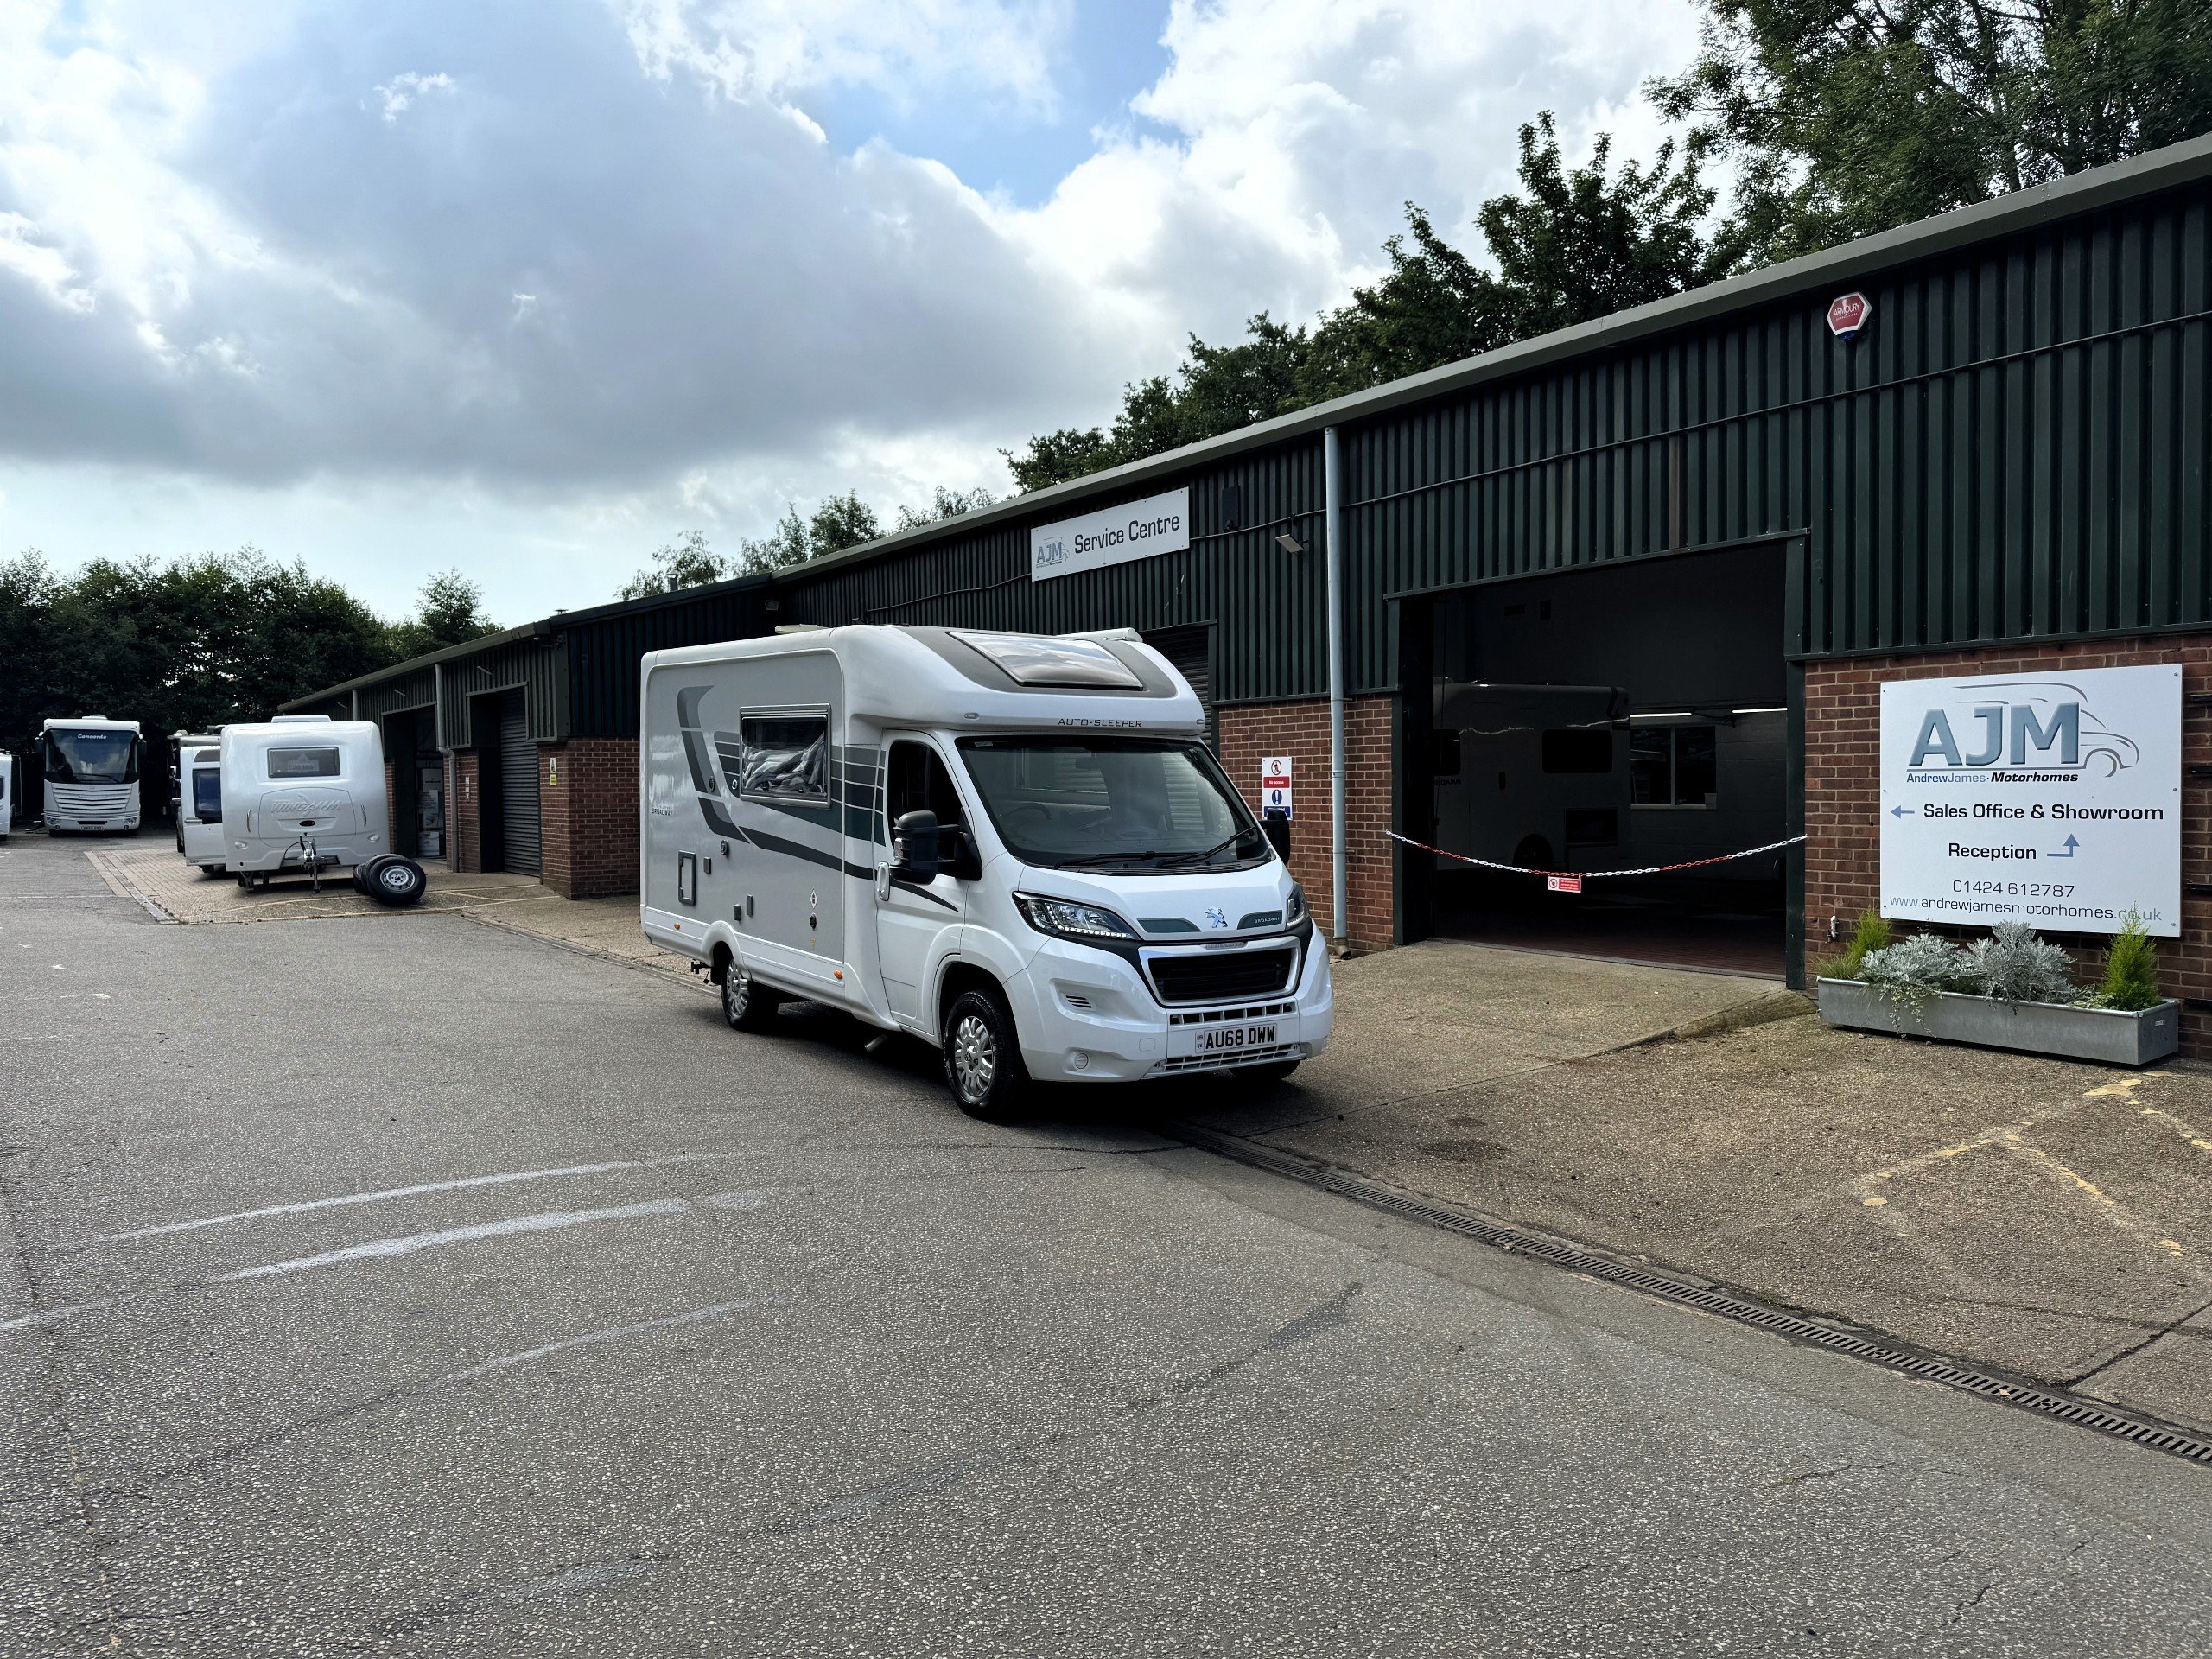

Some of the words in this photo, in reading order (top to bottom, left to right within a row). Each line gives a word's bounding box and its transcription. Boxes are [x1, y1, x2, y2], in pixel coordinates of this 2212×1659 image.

[1036, 541, 1062, 563] AJM
[1074, 527, 1124, 554] Service
[1128, 515, 1179, 541] Centre
[1908, 702, 2080, 766] AJM
[1991, 772, 2079, 783] Motorhomes
[1923, 804, 1967, 819] Sales
[1973, 804, 2024, 819] Office
[2031, 805, 2046, 819] &
[2051, 804, 2164, 820] Showroom
[1948, 843, 2037, 861] Reception
[1953, 880, 2004, 894] 01424
[2007, 883, 2075, 898] 612787
[1205, 1029, 1244, 1050] AU68
[1248, 1025, 1275, 1045] DWW
